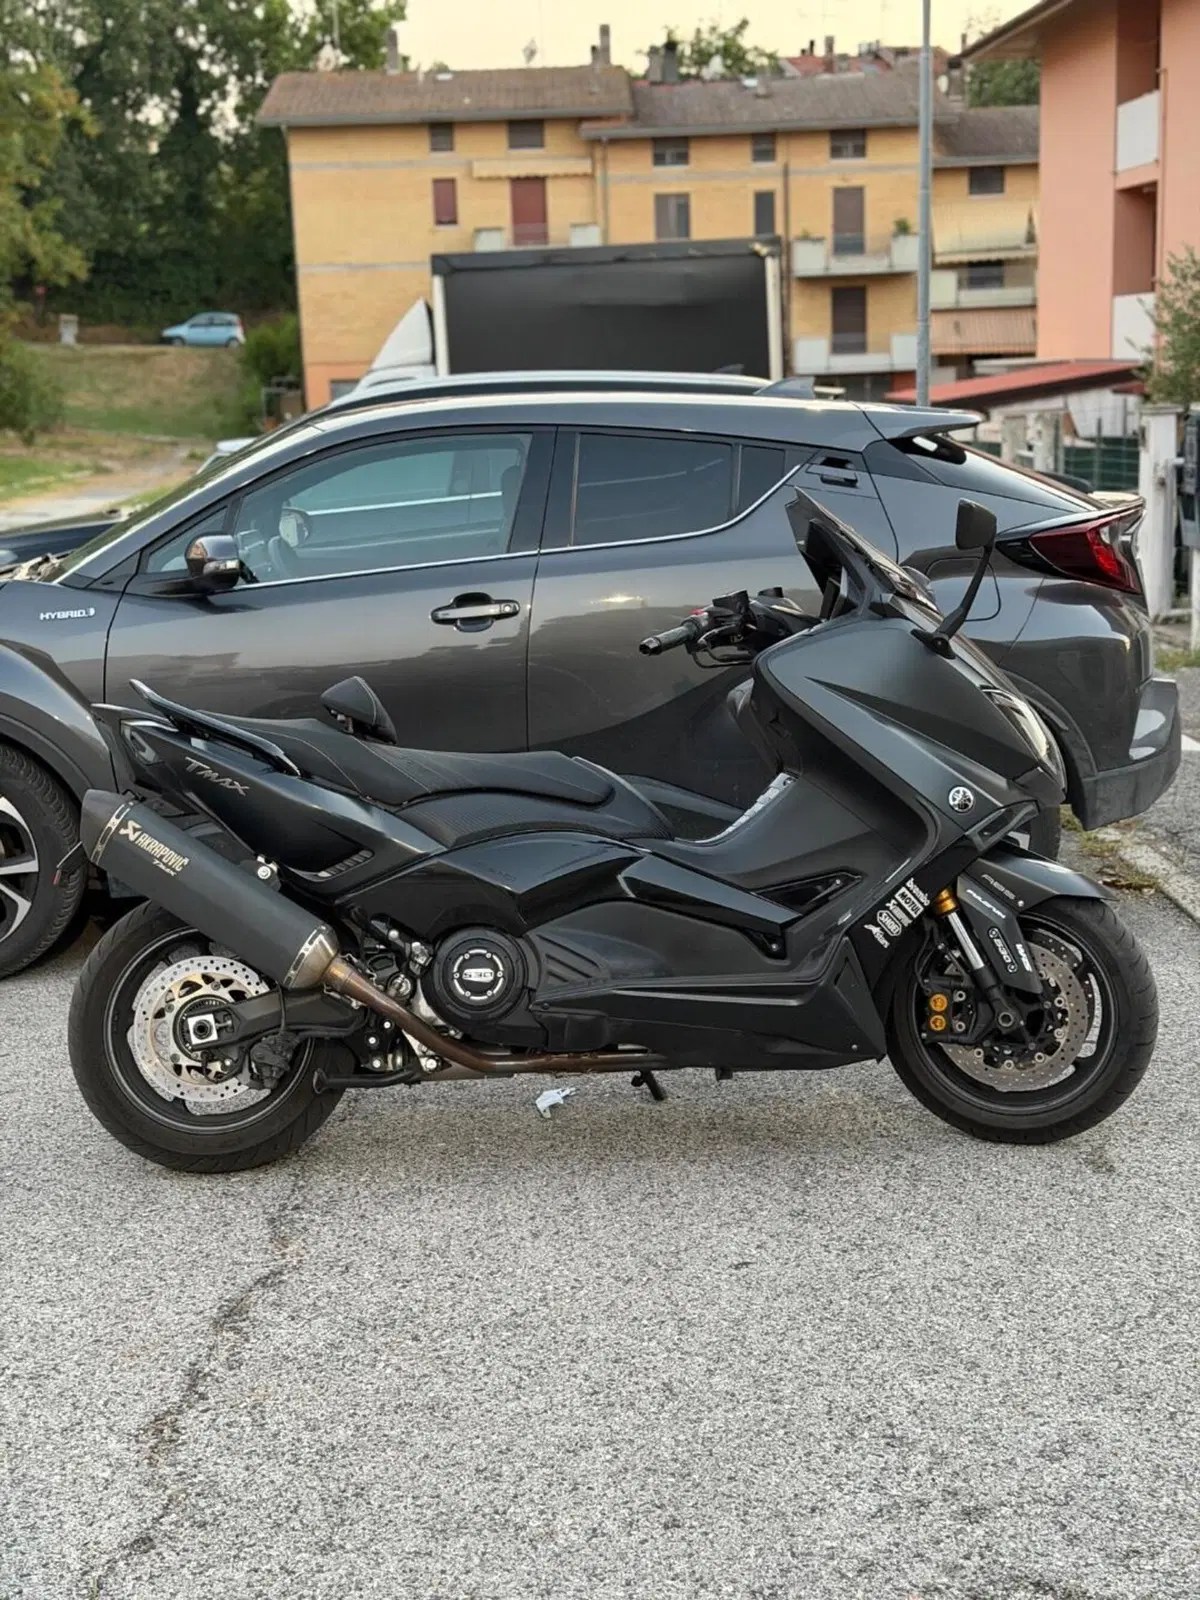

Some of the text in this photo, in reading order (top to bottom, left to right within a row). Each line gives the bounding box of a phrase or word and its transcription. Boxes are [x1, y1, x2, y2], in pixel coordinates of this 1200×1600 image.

[39, 609, 89, 620] HYBRID
[185, 756, 250, 796] TMAX
[898, 891, 920, 916] MOTUL
[905, 877, 930, 906] brembo
[880, 912, 900, 934] SHOEI
[993, 938, 1011, 963] 530
